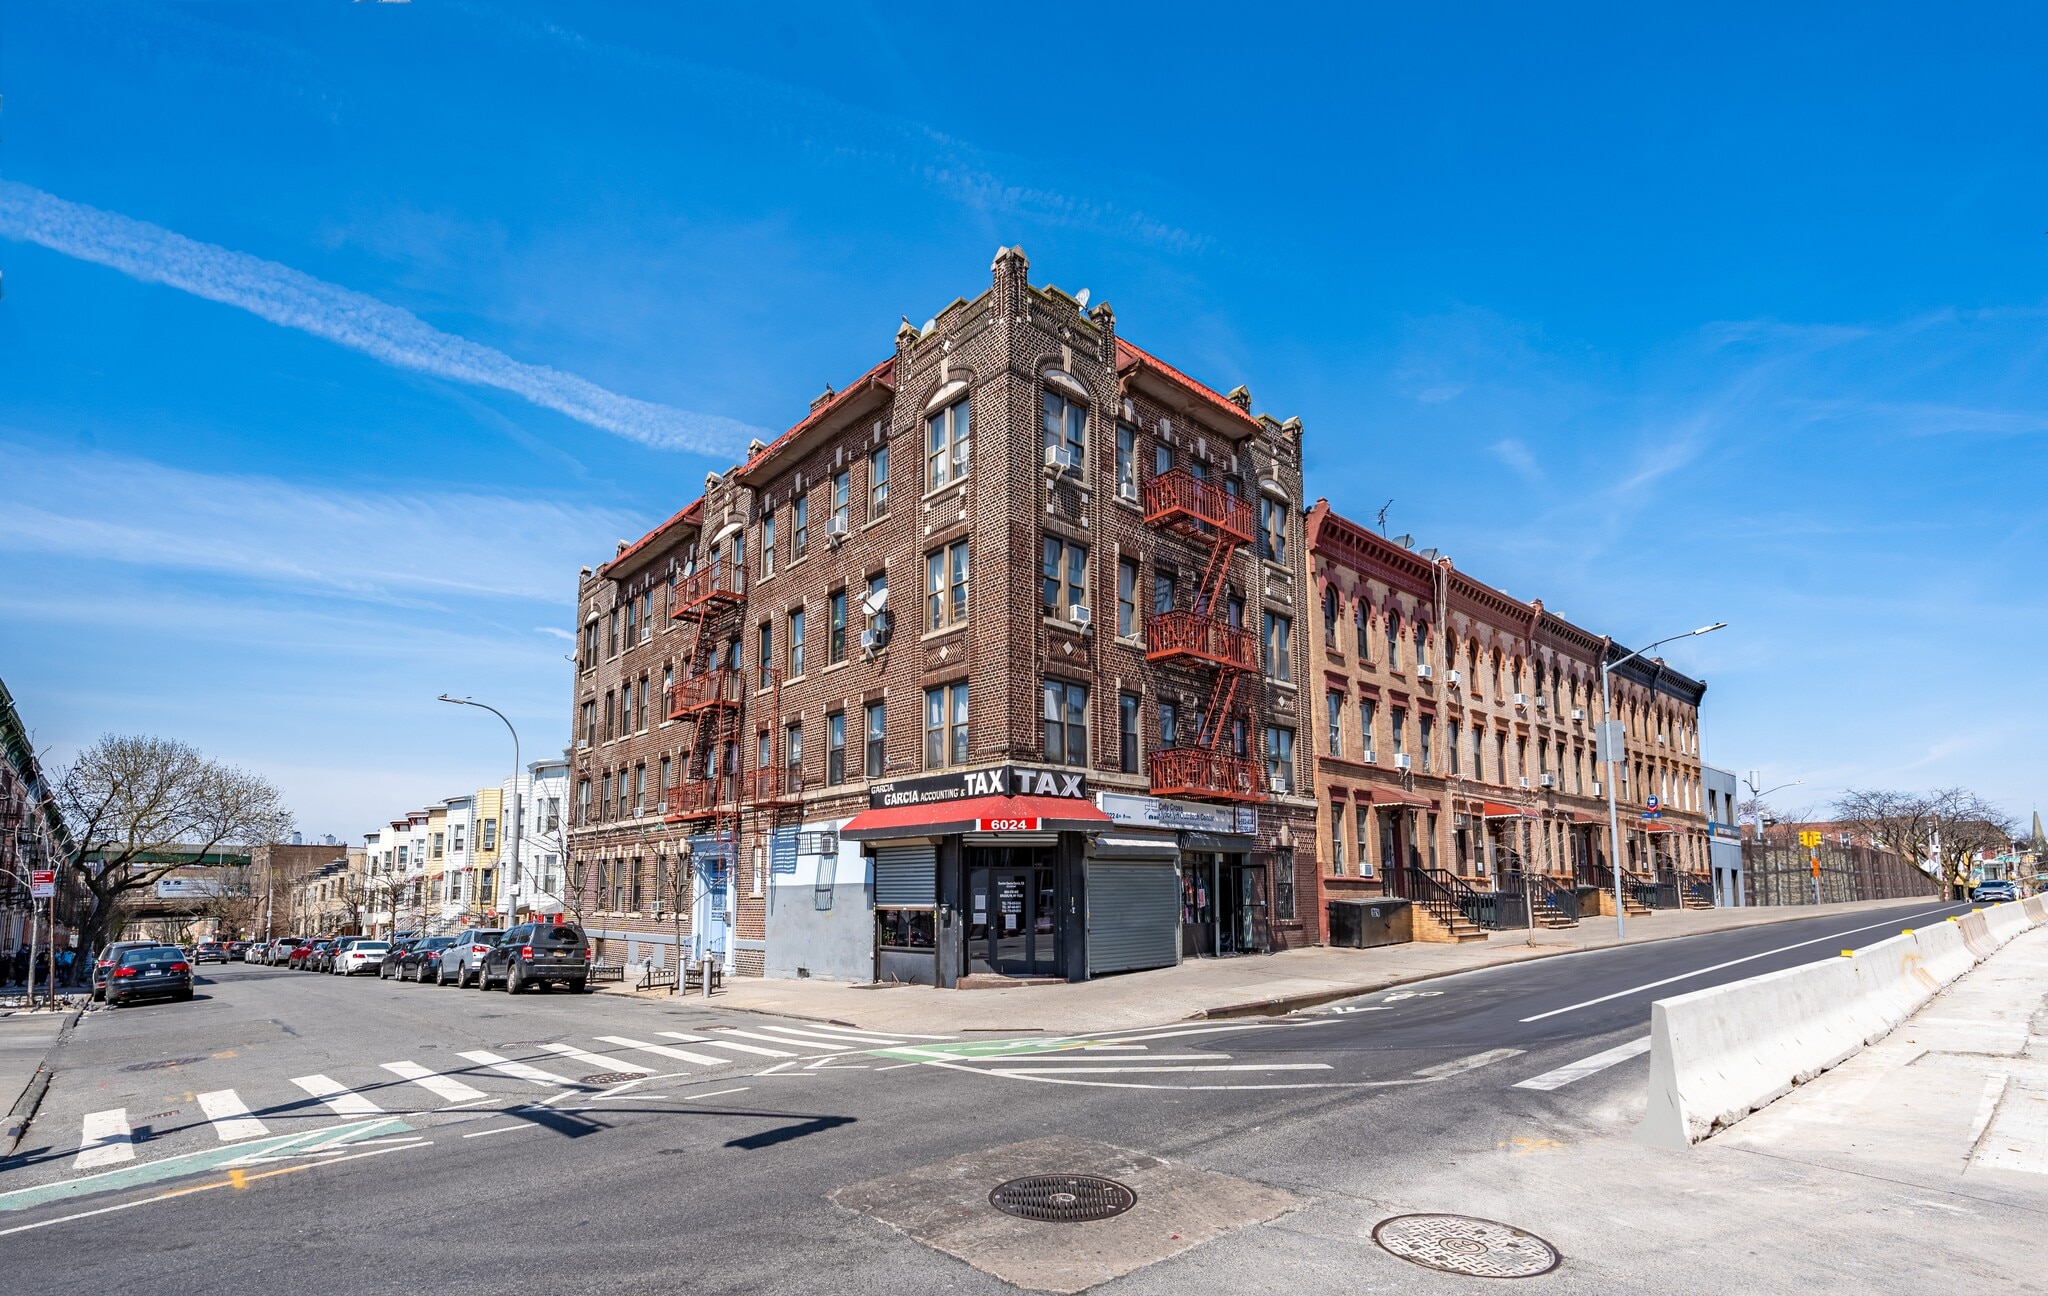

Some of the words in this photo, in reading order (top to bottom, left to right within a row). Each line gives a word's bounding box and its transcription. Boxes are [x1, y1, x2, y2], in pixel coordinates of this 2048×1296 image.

[871, 783, 895, 795] GARCIA
[884, 789, 919, 806] GARCIA
[920, 788, 960, 802] ACCOUNTING
[960, 788, 966, 797] &
[964, 769, 1004, 796] TAX
[1013, 768, 1083, 798] TAX
[990, 819, 1028, 830] 6024
